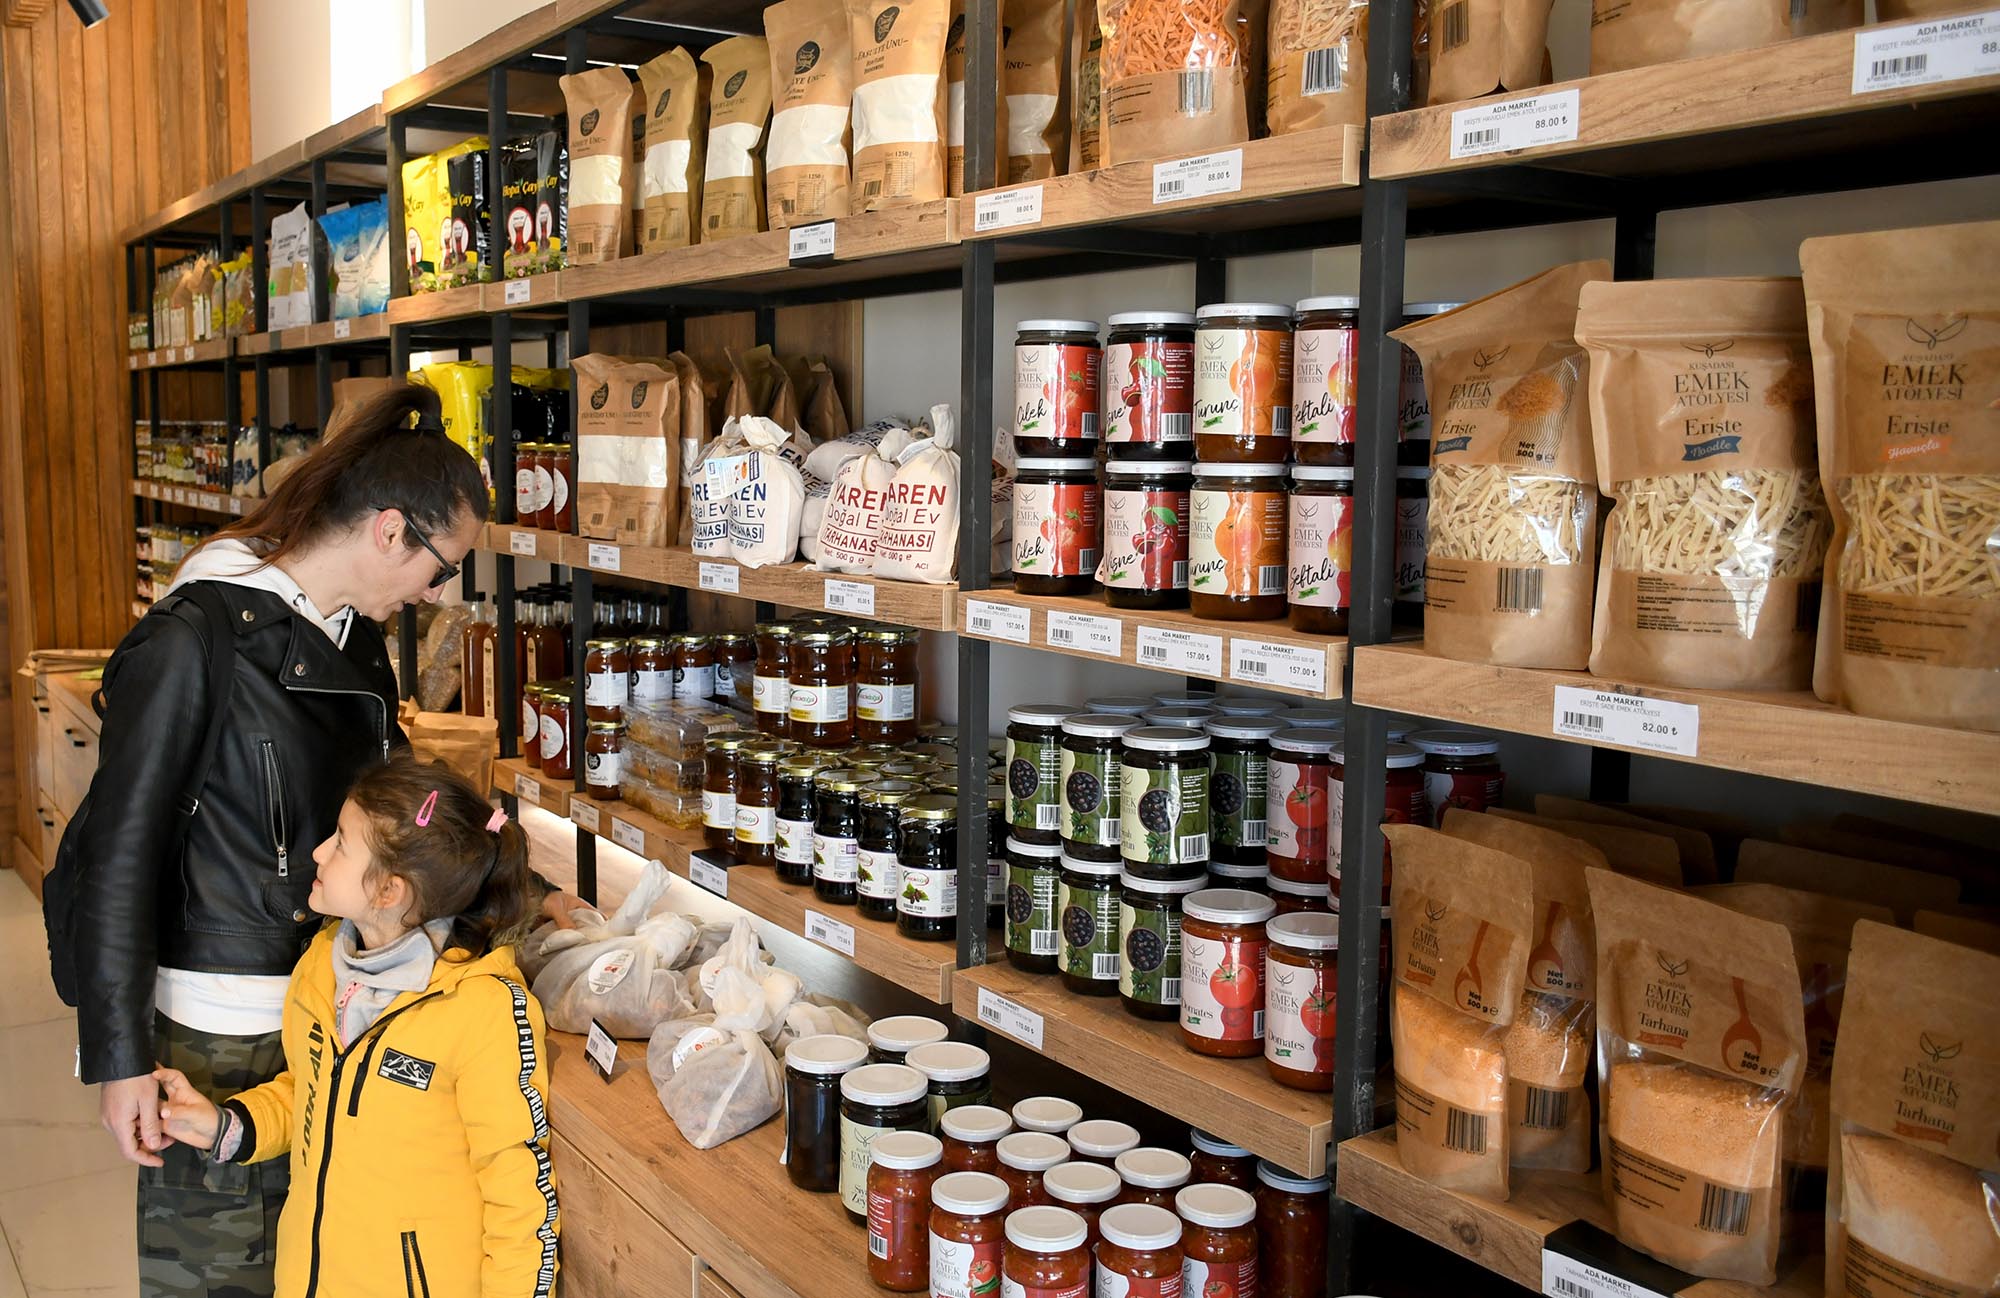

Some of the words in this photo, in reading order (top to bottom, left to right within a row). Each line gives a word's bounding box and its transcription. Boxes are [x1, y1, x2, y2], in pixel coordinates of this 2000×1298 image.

[1917, 27, 1938, 36] ADA
[1941, 18, 1984, 32] MARKET
[1492, 105, 1505, 114] ADA
[1508, 100, 1537, 111] MARKET
[1535, 117, 1559, 129] 88.00
[1190, 157, 1210, 166] MARKET
[1882, 363, 1968, 386] EMEK
[1674, 371, 1750, 394] EMEK
[1450, 382, 1492, 400] EMEK
[1675, 390, 1751, 407] ATÖLYESİ
[1440, 419, 1477, 436] Erişte
[1685, 417, 1743, 437] Erişte
[1886, 414, 1951, 436] Erişte
[1518, 440, 1536, 450] Net
[1690, 439, 1731, 459] Noodle
[1516, 450, 1534, 459] 500
[888, 482, 947, 505] AREN
[709, 503, 729, 517] Ev
[746, 505, 766, 519] Ev
[913, 508, 940, 524] Ev
[824, 527, 878, 553] TARHANAS
[1294, 529, 1322, 541] EMEK
[1090, 633, 1106, 642] 157.00
[1172, 633, 1191, 641] MARKET
[1186, 651, 1205, 661] 157.00
[1261, 645, 1273, 653] ADA
[1274, 646, 1295, 654] MARKET
[1289, 666, 1310, 677] 157.00
[1596, 694, 1611, 703] ADA
[1613, 696, 1644, 708] MARKET
[1642, 722, 1669, 734] 82.00
[1412, 926, 1441, 949] EMEK
[1407, 952, 1436, 977] Tarhana
[1546, 977, 1563, 987] 500
[1547, 970, 1563, 979] Net
[1270, 991, 1299, 1009] EMEK
[1469, 990, 1482, 1001] Net
[1645, 983, 1693, 1009] EMEK
[1638, 1011, 1689, 1038] Tarhana
[1268, 1032, 1305, 1051] Domates
[1743, 1051, 1759, 1062] Net
[1741, 1060, 1757, 1071] 500
[1903, 1066, 1960, 1099] EMEK
[1896, 1099, 1956, 1132] Tarhana
[936, 1261, 960, 1275] EMEK
[1584, 1268, 1599, 1279] ADA
[1601, 1276, 1631, 1292] MARKET
